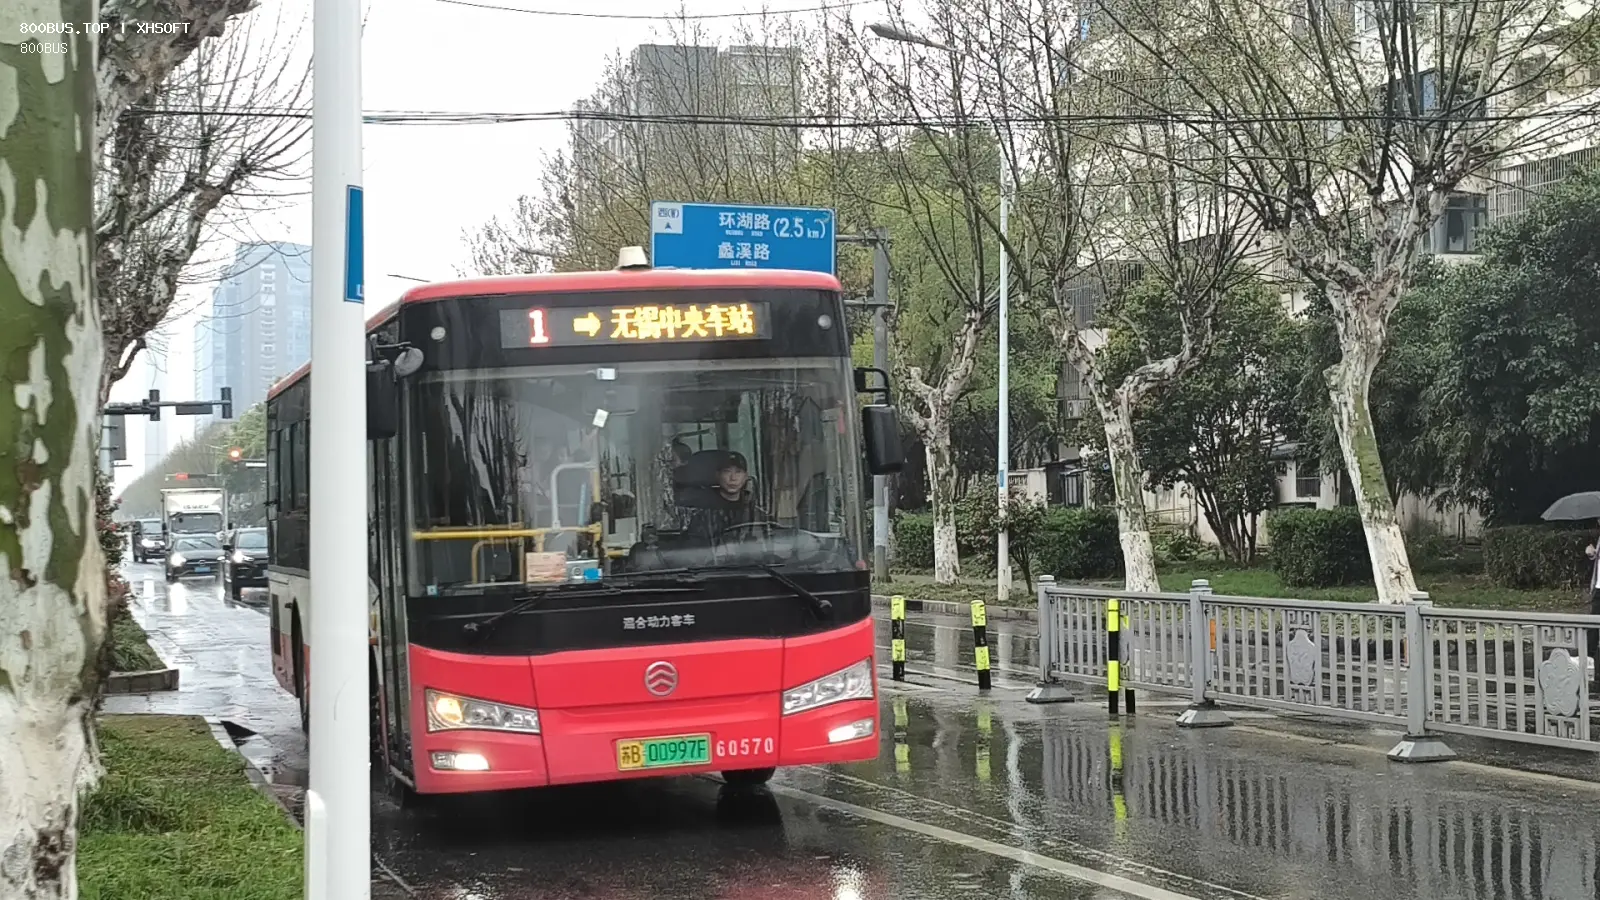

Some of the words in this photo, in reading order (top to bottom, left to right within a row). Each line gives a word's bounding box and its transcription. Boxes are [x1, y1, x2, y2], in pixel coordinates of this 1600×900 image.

[719, 212, 770, 230] 环湖路
[718, 242, 770, 260] 蠡溪路
[529, 309, 549, 343] 1
[610, 303, 754, 339] 无锡中央车站
[623, 613, 696, 630] 混合动力客车
[716, 737, 774, 757] 60570
